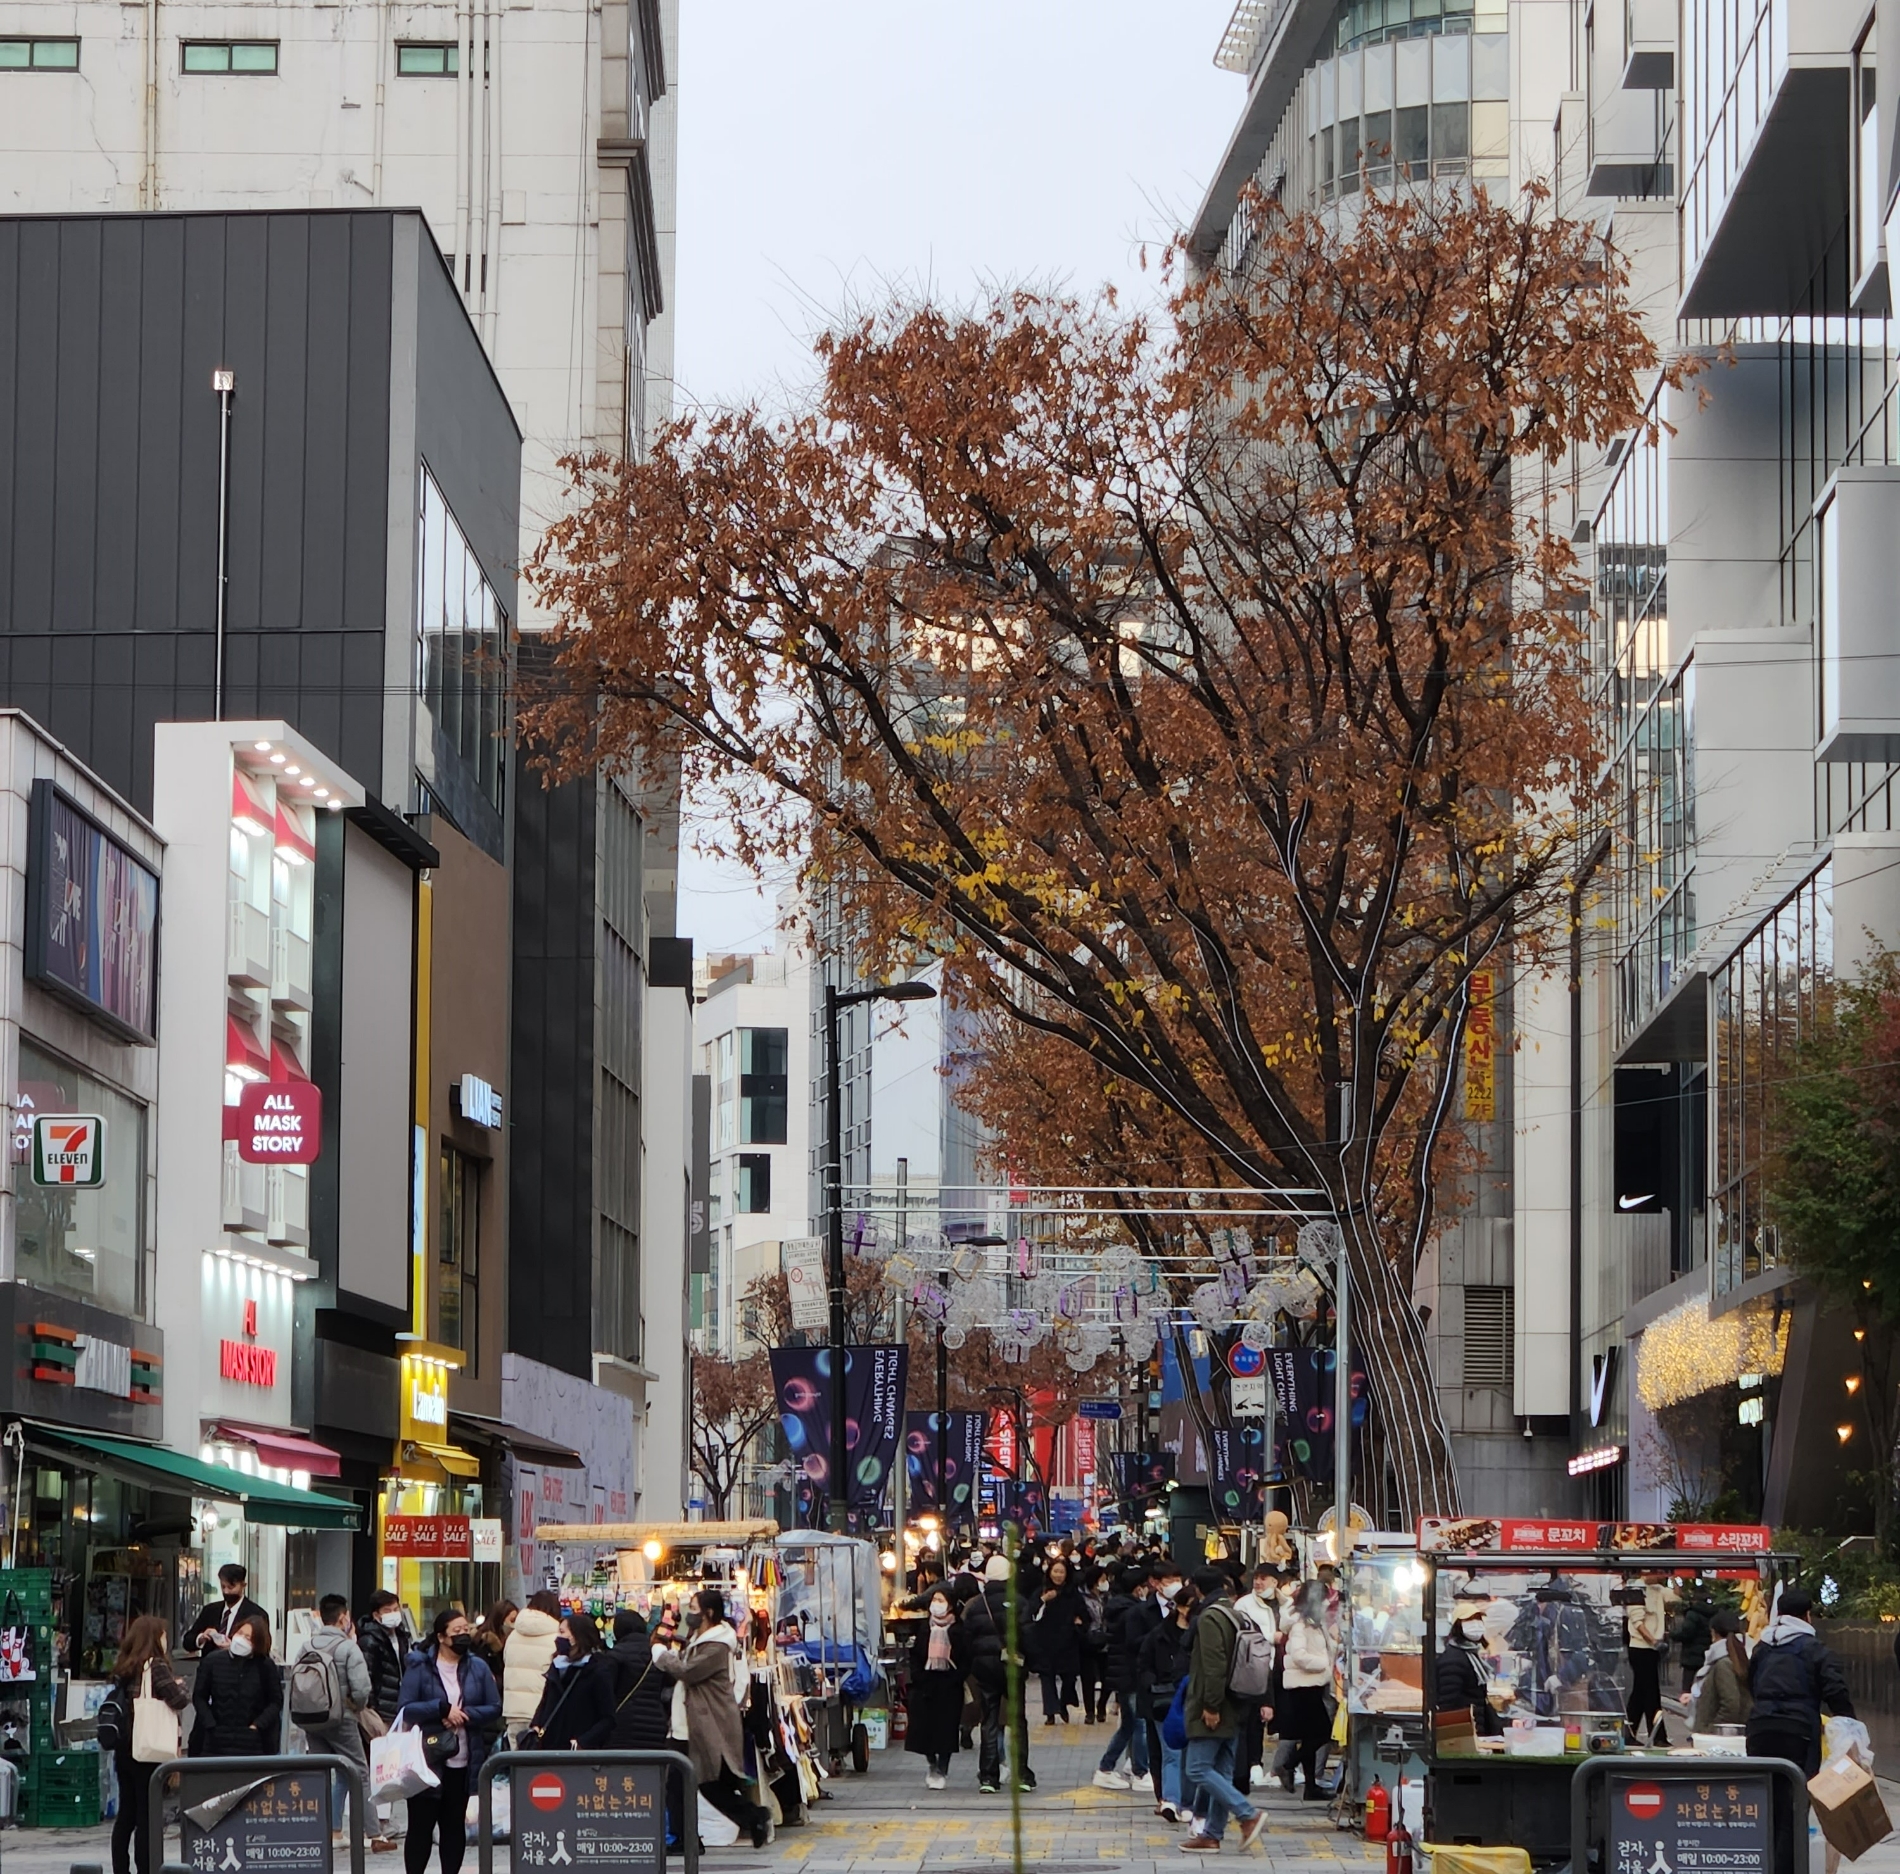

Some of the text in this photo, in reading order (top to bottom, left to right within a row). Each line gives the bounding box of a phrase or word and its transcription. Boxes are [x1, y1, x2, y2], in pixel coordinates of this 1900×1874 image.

[1469, 975, 1491, 1067] 부동산
[263, 1095, 295, 1110] ALL
[254, 1114, 302, 1131] MASK
[252, 1136, 303, 1152] STORY
[220, 1339, 277, 1387] MASK STORY
[1284, 1352, 1298, 1412] EVERYTHING
[385, 1532, 408, 1541] SALE
[414, 1532, 438, 1541] SALE
[444, 1532, 467, 1542] SALE
[1547, 1527, 1587, 1544] 문꼬치
[1717, 1532, 1764, 1549] 소라꼬치
[192, 1838, 220, 1854] 걷자,
[522, 1831, 550, 1847] 걷자,
[246, 1847, 320, 1859] 매일 10:00~23:00
[576, 1843, 654, 1854] 매일 10:00~23:00
[1618, 1841, 1648, 1857] 걷자,
[192, 1856, 216, 1872] 서울
[522, 1850, 546, 1866] 서울
[1677, 1853, 1760, 1866] 매일 10:00~23:00
[1618, 1859, 1644, 1874] 서울
